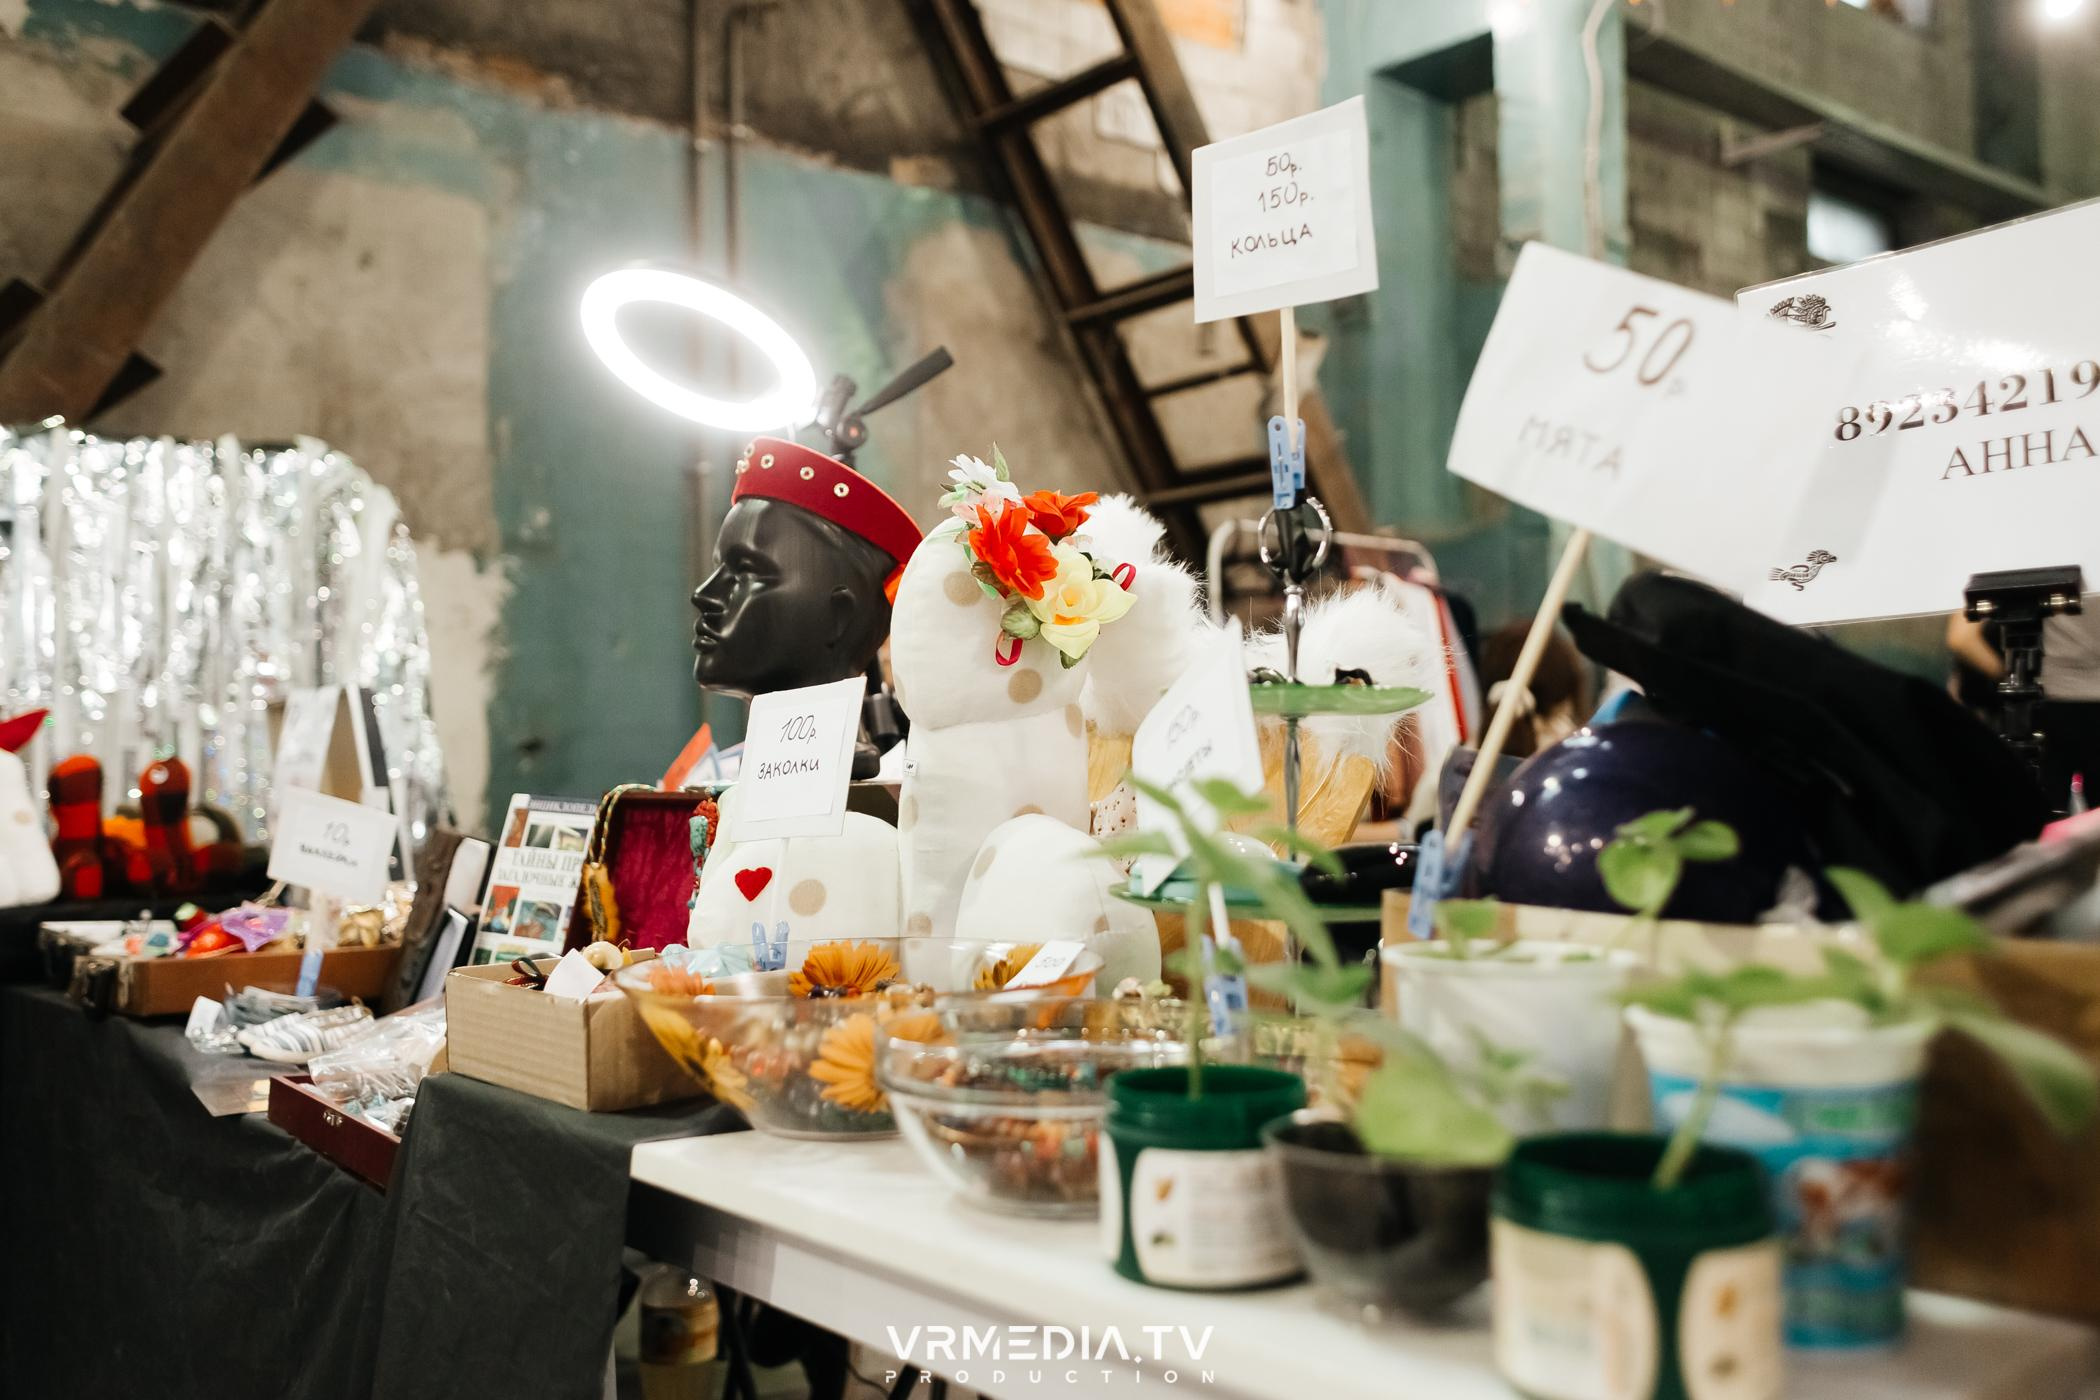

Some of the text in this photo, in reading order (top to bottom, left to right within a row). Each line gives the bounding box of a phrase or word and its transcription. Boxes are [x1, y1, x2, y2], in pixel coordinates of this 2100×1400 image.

[1231, 223, 1313, 259] КОЛЬЦА
[1517, 413, 1624, 480] МЯТА
[1939, 425, 2099, 480] АННА
[758, 758, 820, 780] ЗАКОЛКИ
